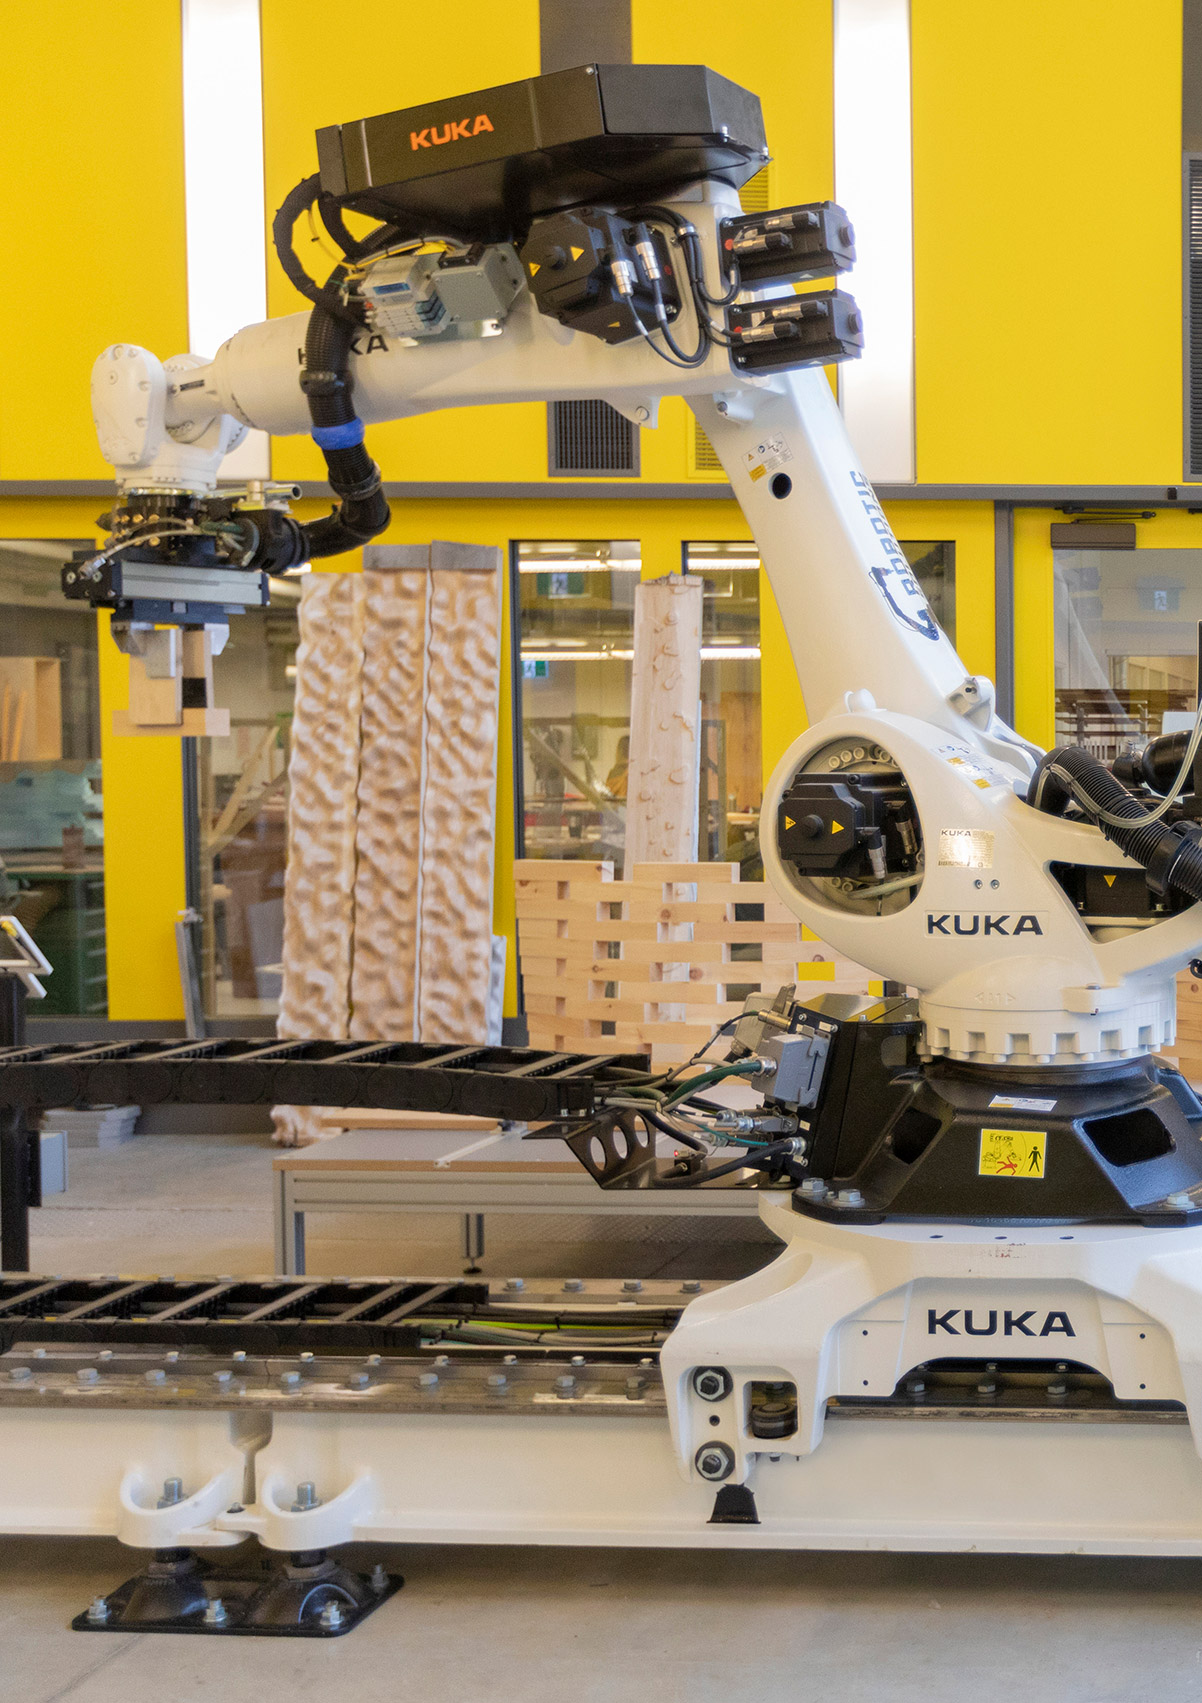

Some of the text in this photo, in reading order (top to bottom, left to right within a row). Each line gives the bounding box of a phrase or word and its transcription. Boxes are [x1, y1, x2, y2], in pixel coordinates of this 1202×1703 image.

[409, 113, 495, 151] KUKA
[941, 829, 971, 837] KUKA
[927, 914, 1043, 936] KUKA
[927, 1309, 1077, 1337] KUKA
